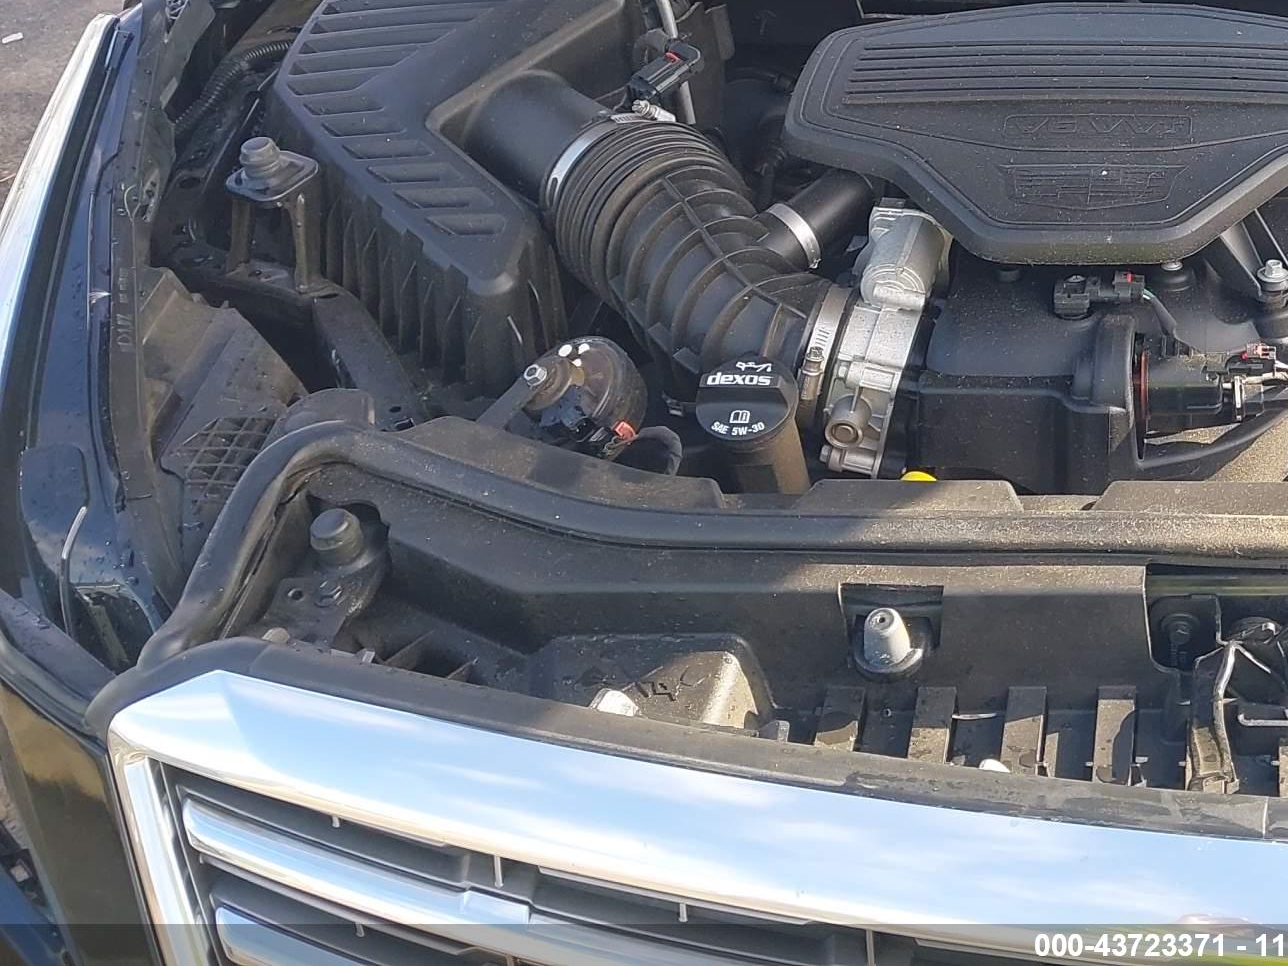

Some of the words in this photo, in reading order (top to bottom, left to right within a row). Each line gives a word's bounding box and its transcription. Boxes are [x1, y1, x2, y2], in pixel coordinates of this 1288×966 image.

[706, 371, 774, 386] dexos
[711, 421, 731, 434] SAE
[731, 421, 765, 436] 5W-30
